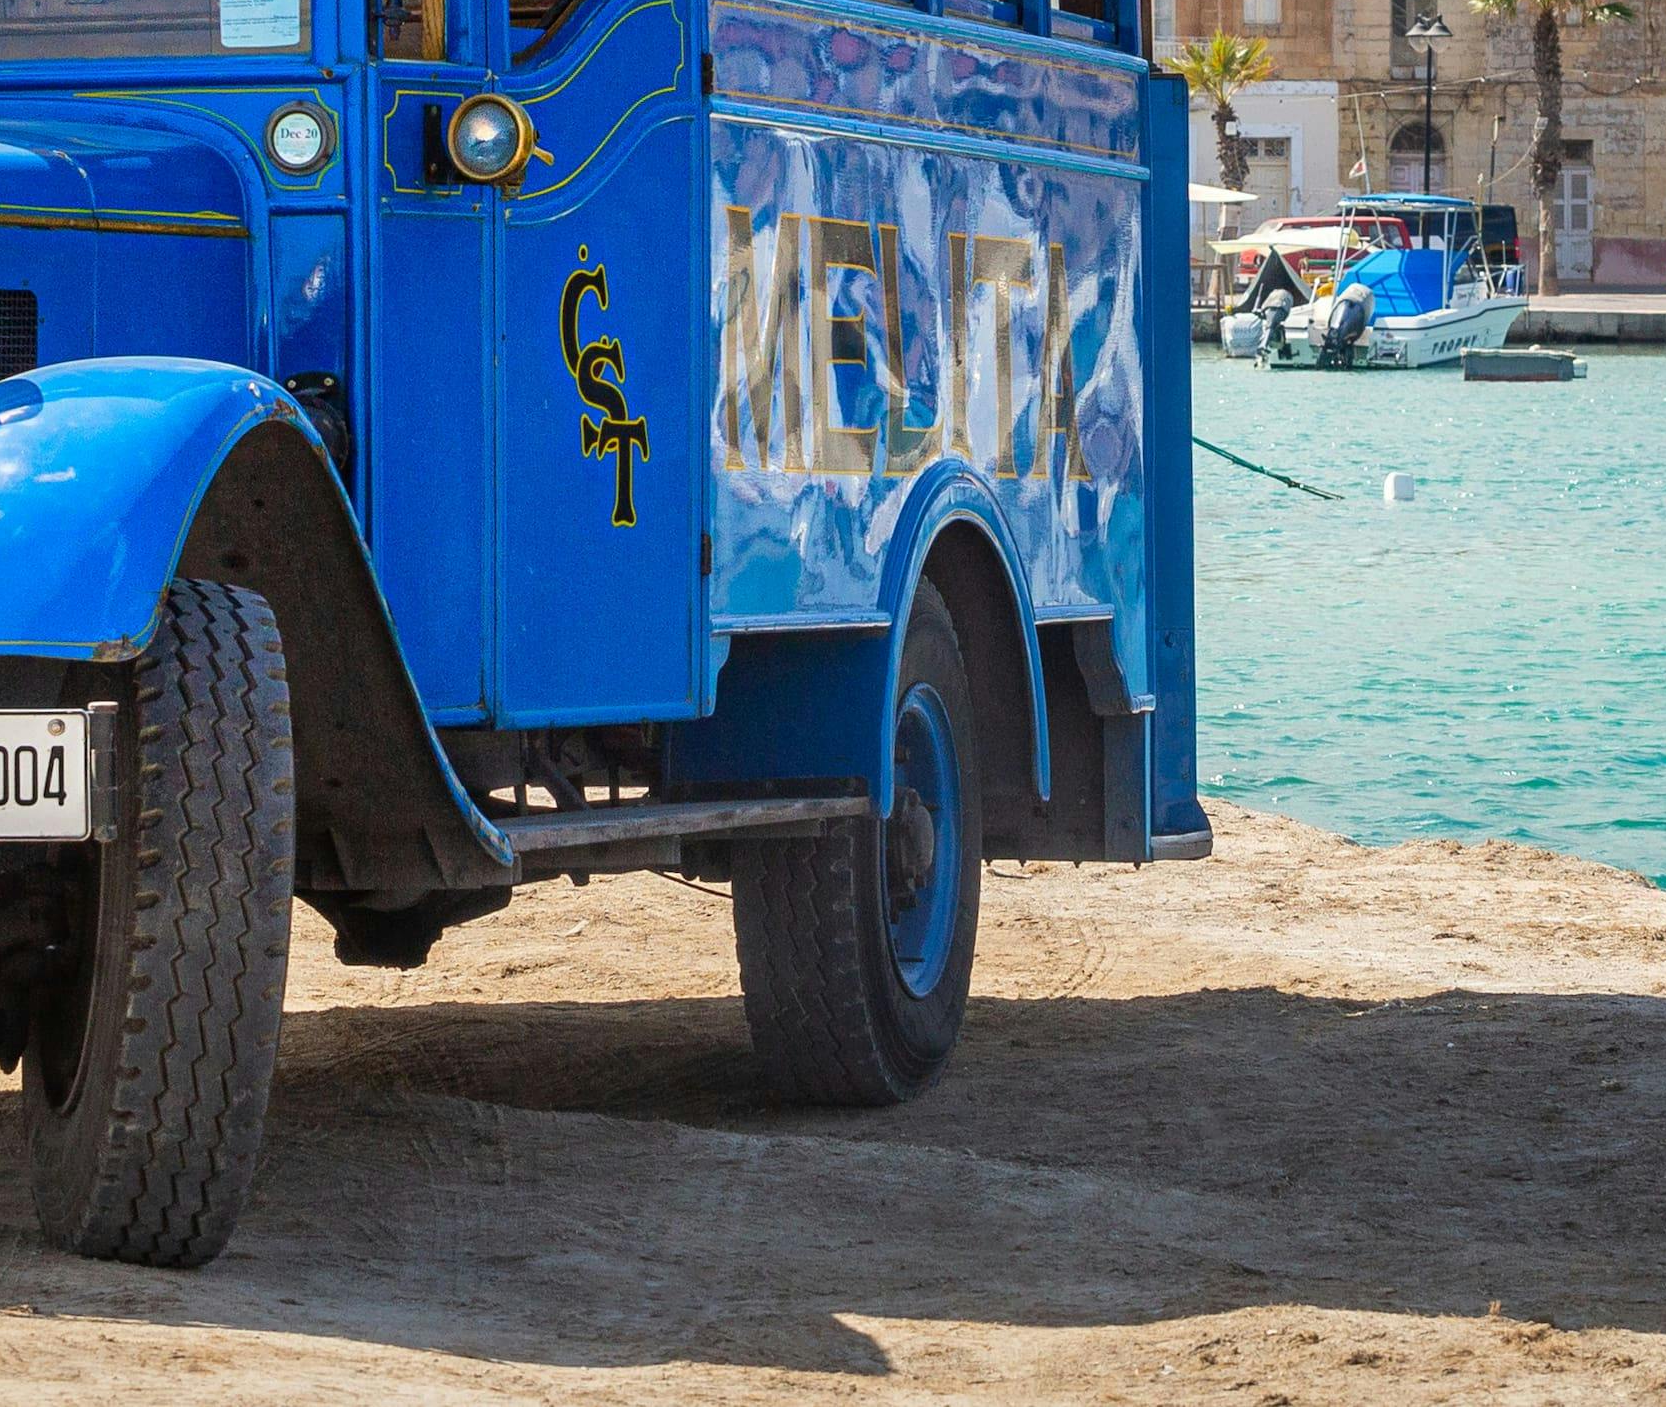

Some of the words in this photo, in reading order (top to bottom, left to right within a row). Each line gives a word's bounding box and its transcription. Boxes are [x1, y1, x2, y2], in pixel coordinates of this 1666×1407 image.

[280, 128, 302, 139] Dec
[304, 128, 318, 139] 20
[725, 205, 1092, 482] MELITA
[1431, 334, 1478, 356] TROPHY
